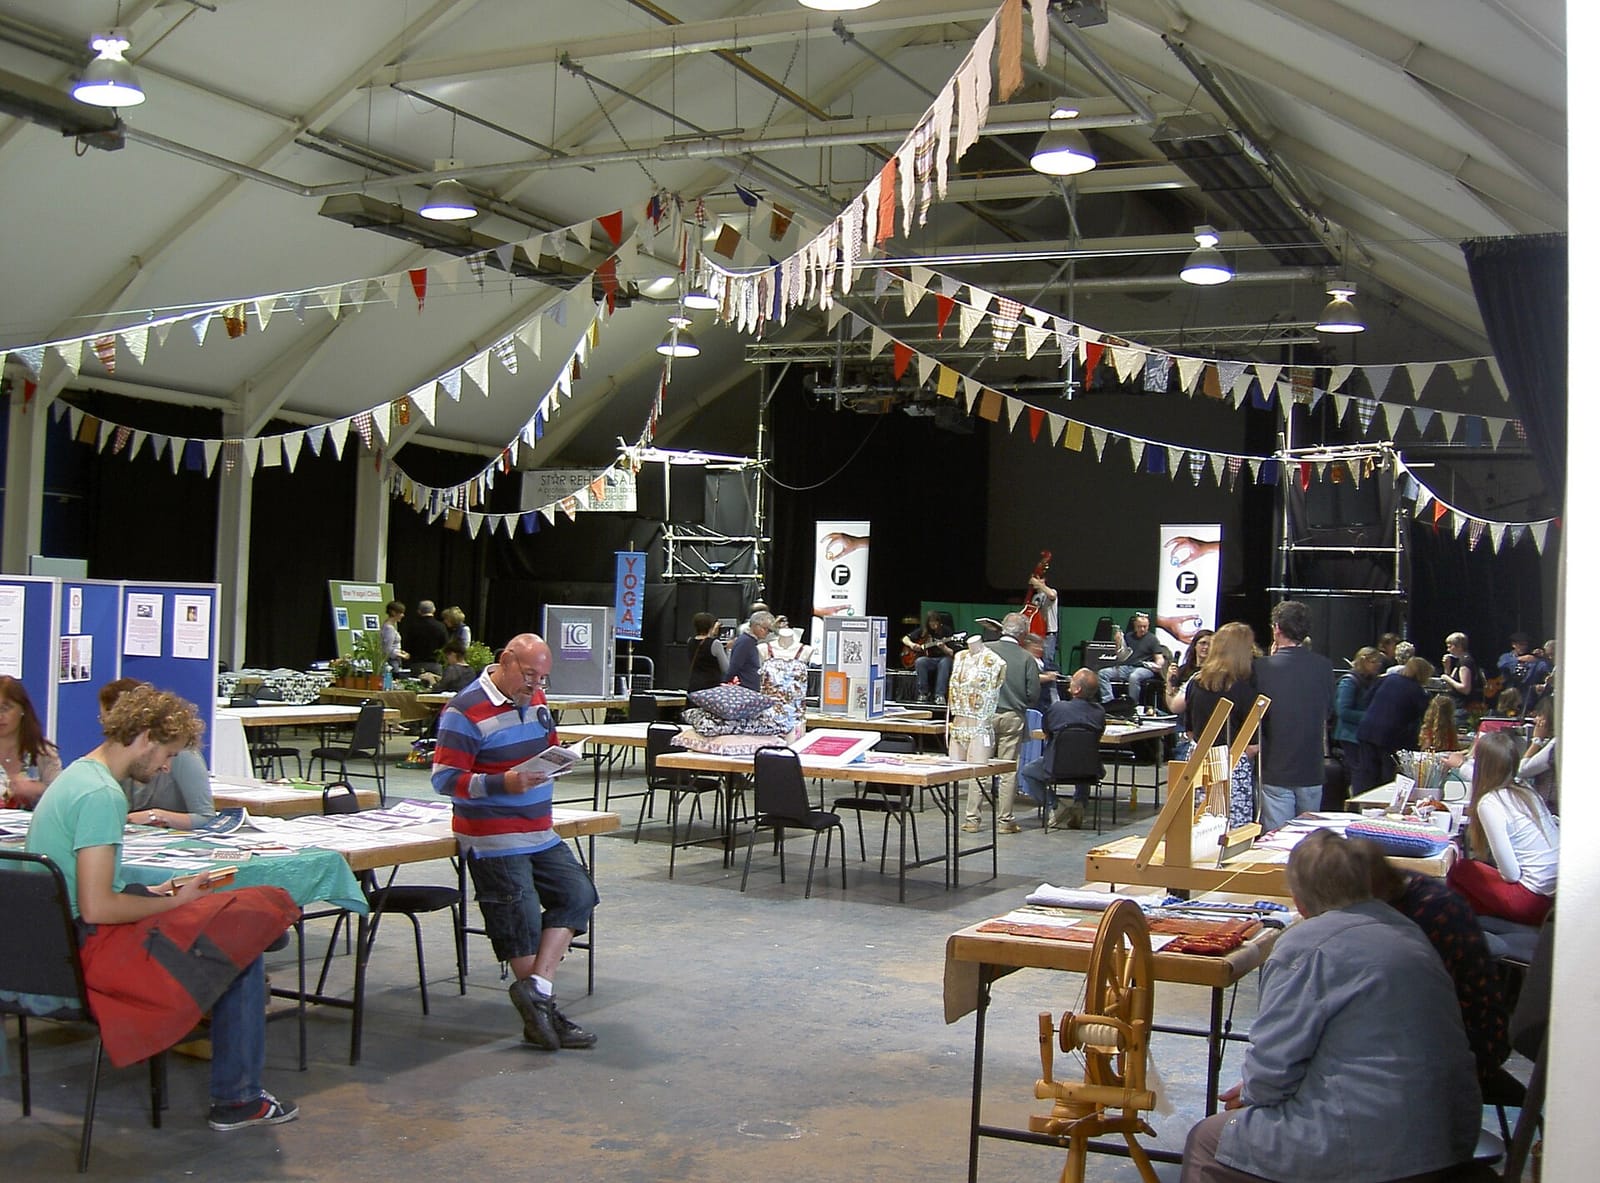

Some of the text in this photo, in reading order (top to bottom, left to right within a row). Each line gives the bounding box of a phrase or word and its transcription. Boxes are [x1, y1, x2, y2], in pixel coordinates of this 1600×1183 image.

[834, 566, 849, 584] F
[1180, 573, 1196, 592] F
[621, 556, 638, 625] YOGA
